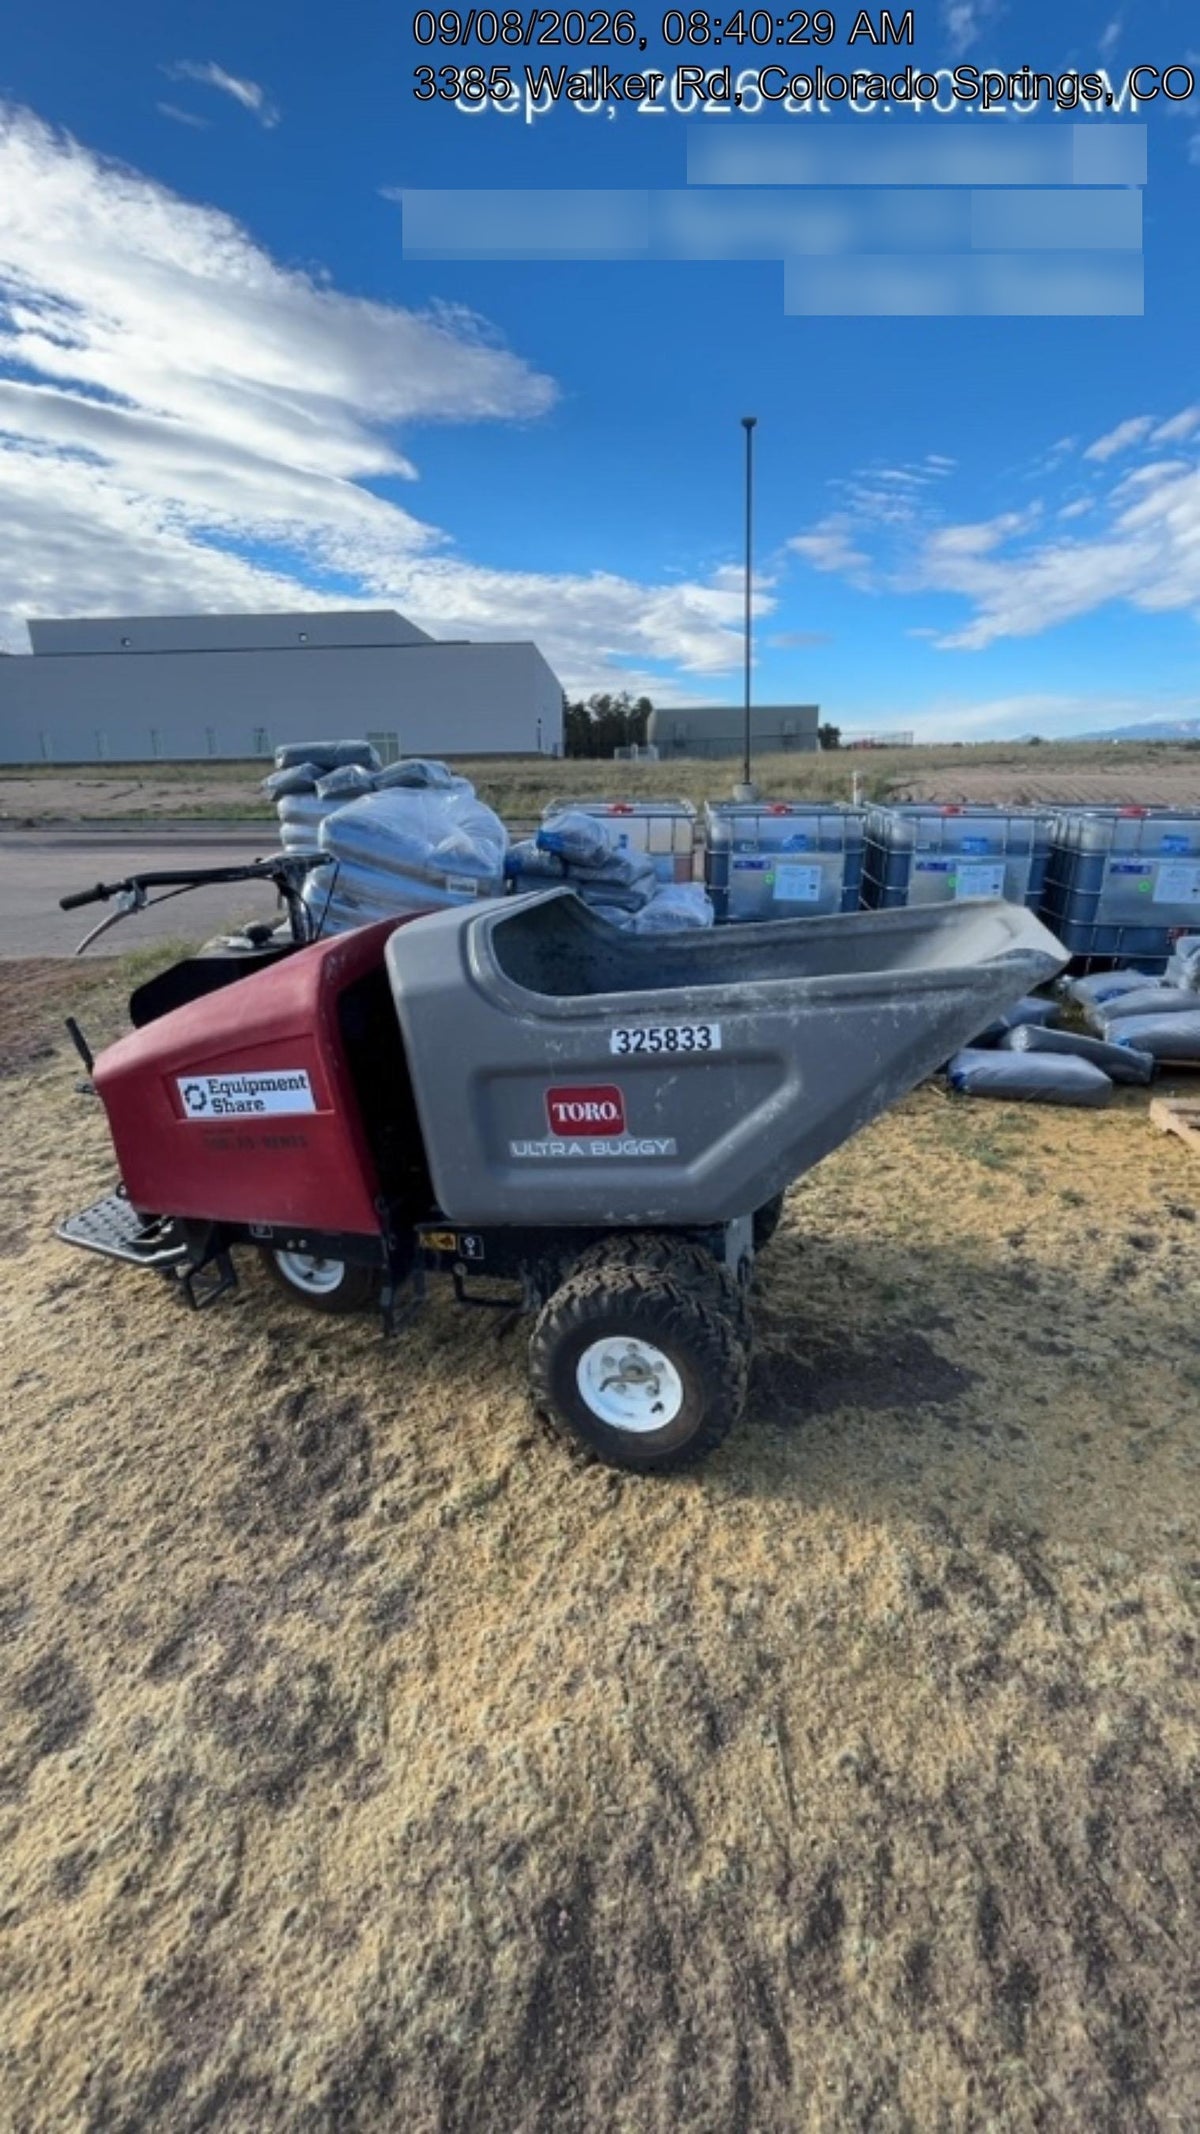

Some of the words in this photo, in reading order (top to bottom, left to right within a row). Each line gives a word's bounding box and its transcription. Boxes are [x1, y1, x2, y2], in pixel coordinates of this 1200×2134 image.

[616, 1026, 712, 1053] 325833
[206, 1074, 308, 1097] Equipment
[211, 1097, 266, 1113] Share
[552, 1100, 618, 1122] TORO
[511, 1142, 584, 1156] ULTRA
[591, 1140, 671, 1154] BUGGY
